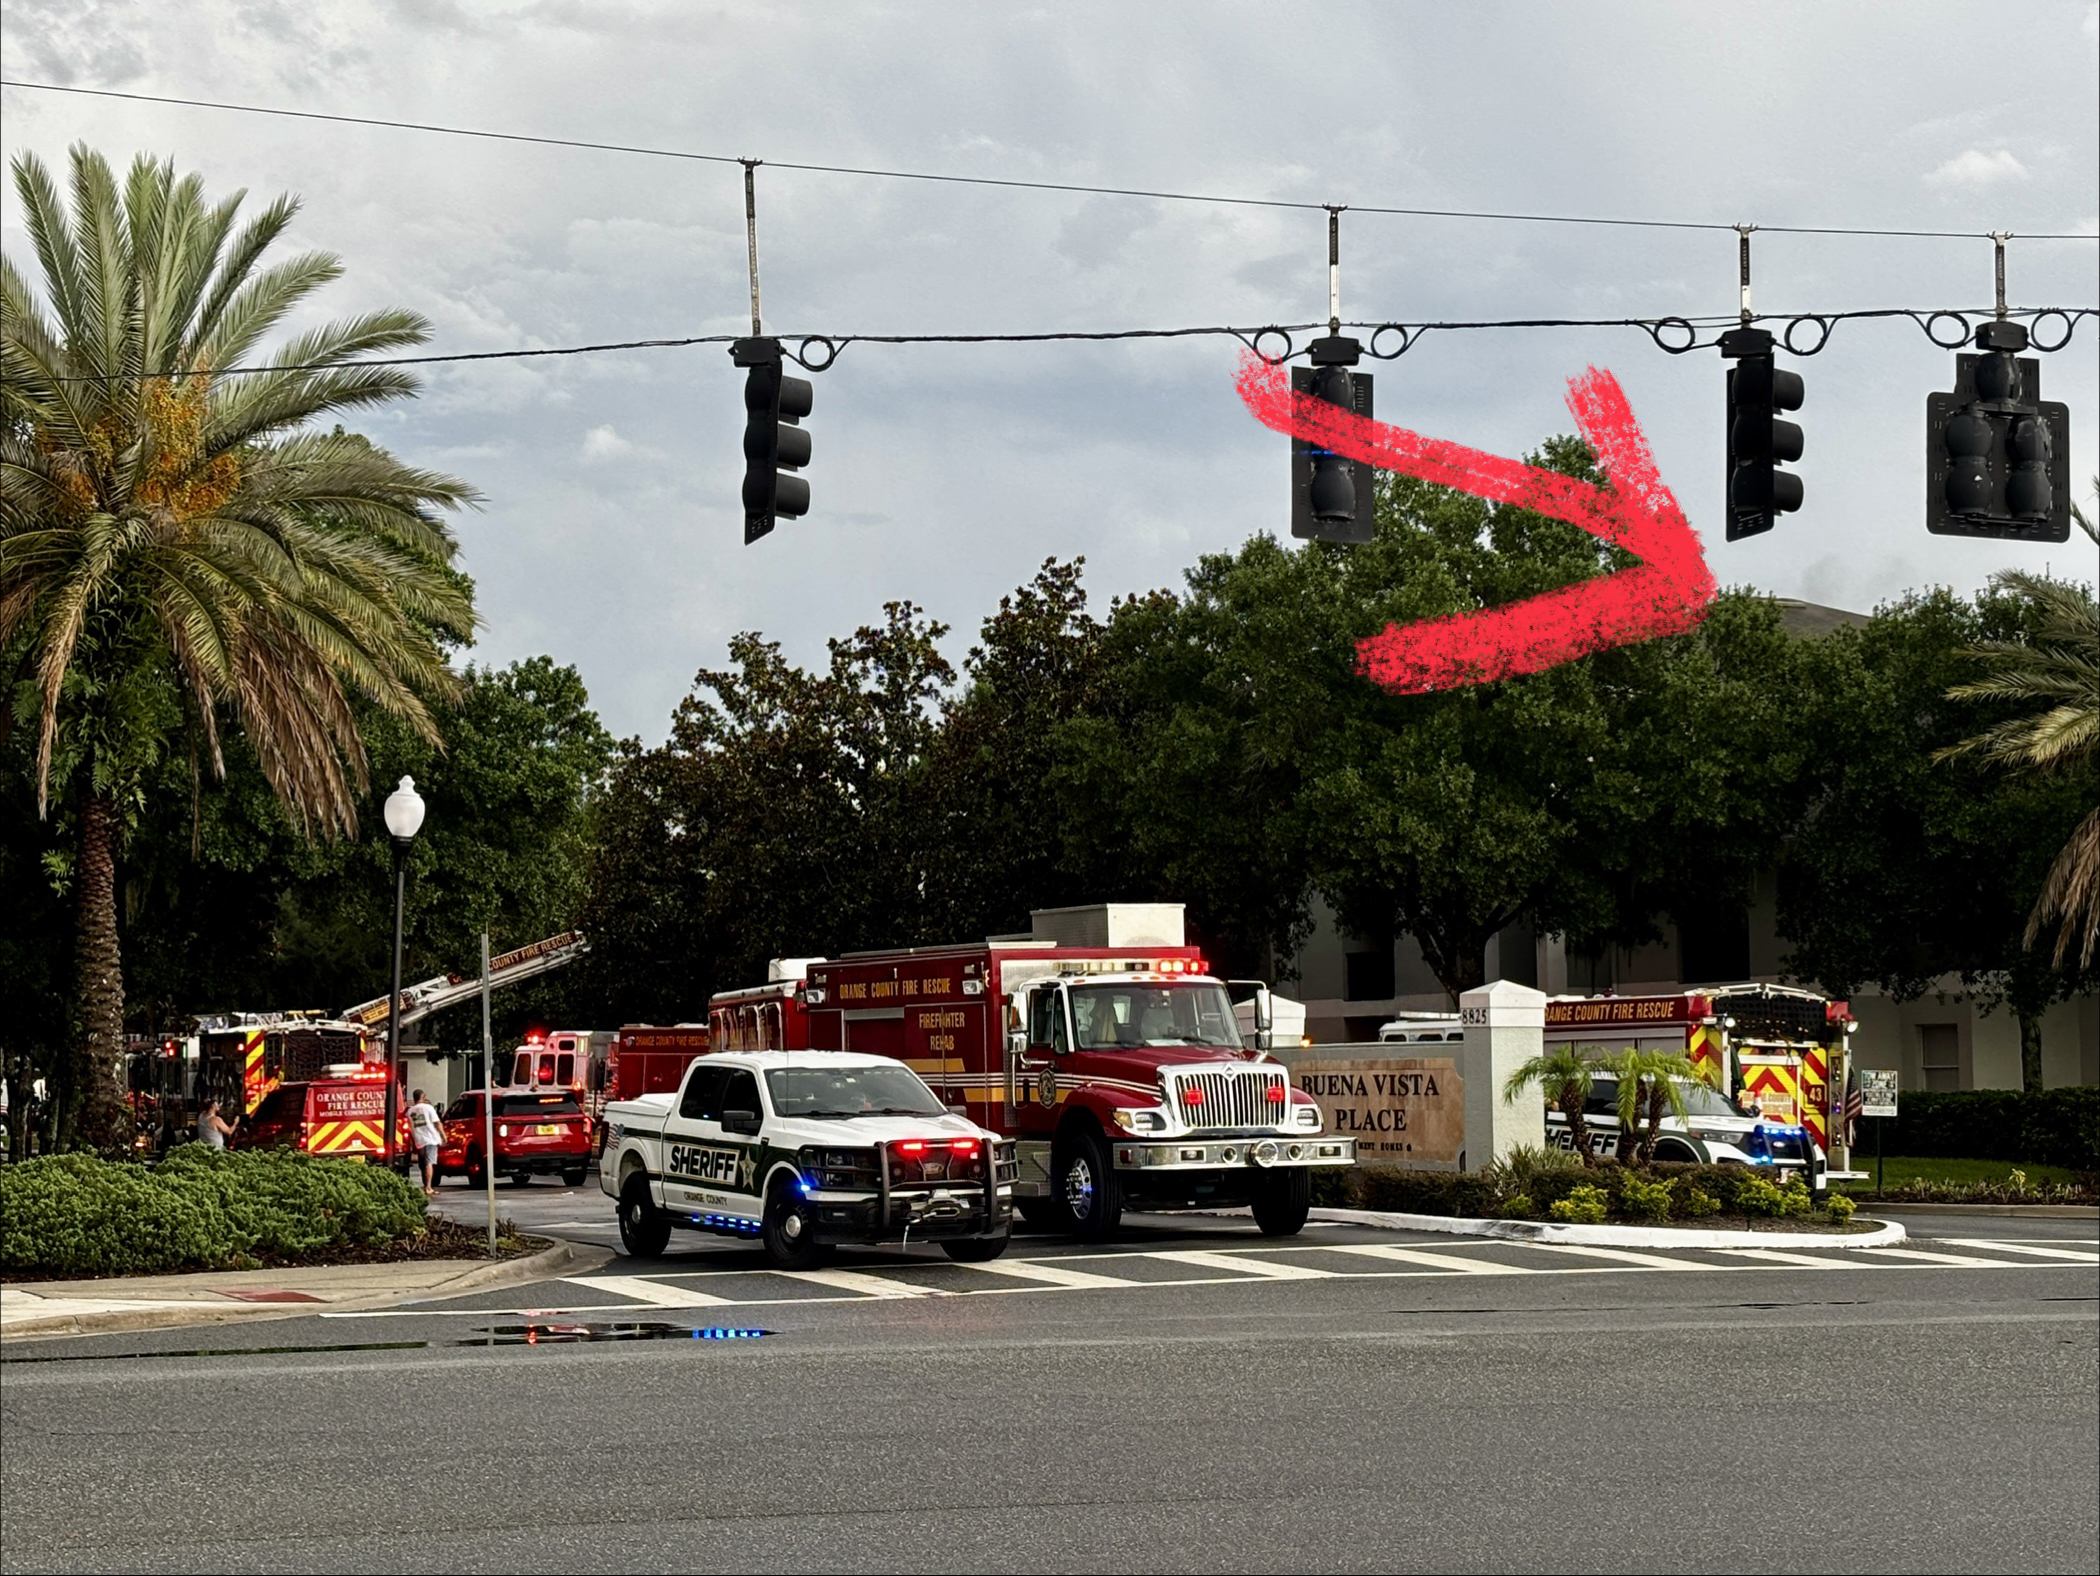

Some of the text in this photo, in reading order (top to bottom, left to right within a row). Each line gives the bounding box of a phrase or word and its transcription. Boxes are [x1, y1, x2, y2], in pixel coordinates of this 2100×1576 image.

[521, 945, 540, 960] FIRE
[541, 934, 573, 951] RESCUE
[840, 978, 950, 999] ORANGE COUNTY FIRE RESCUE
[1462, 1009, 1487, 1024] 8825
[1544, 1001, 1675, 1022] RANGE COUNTY FIRE RESCUE
[930, 1035, 954, 1050] REHAB
[1301, 1074, 1439, 1096] BUENA VISTA
[1809, 1087, 1822, 1101] 43
[316, 1092, 354, 1102] ORANGE
[327, 1099, 385, 1110] FIRE RESCUE
[1335, 1108, 1406, 1131] PLACE
[669, 1145, 736, 1180] SHERIFF
[683, 1191, 728, 1206] ORANGE COUNTY
